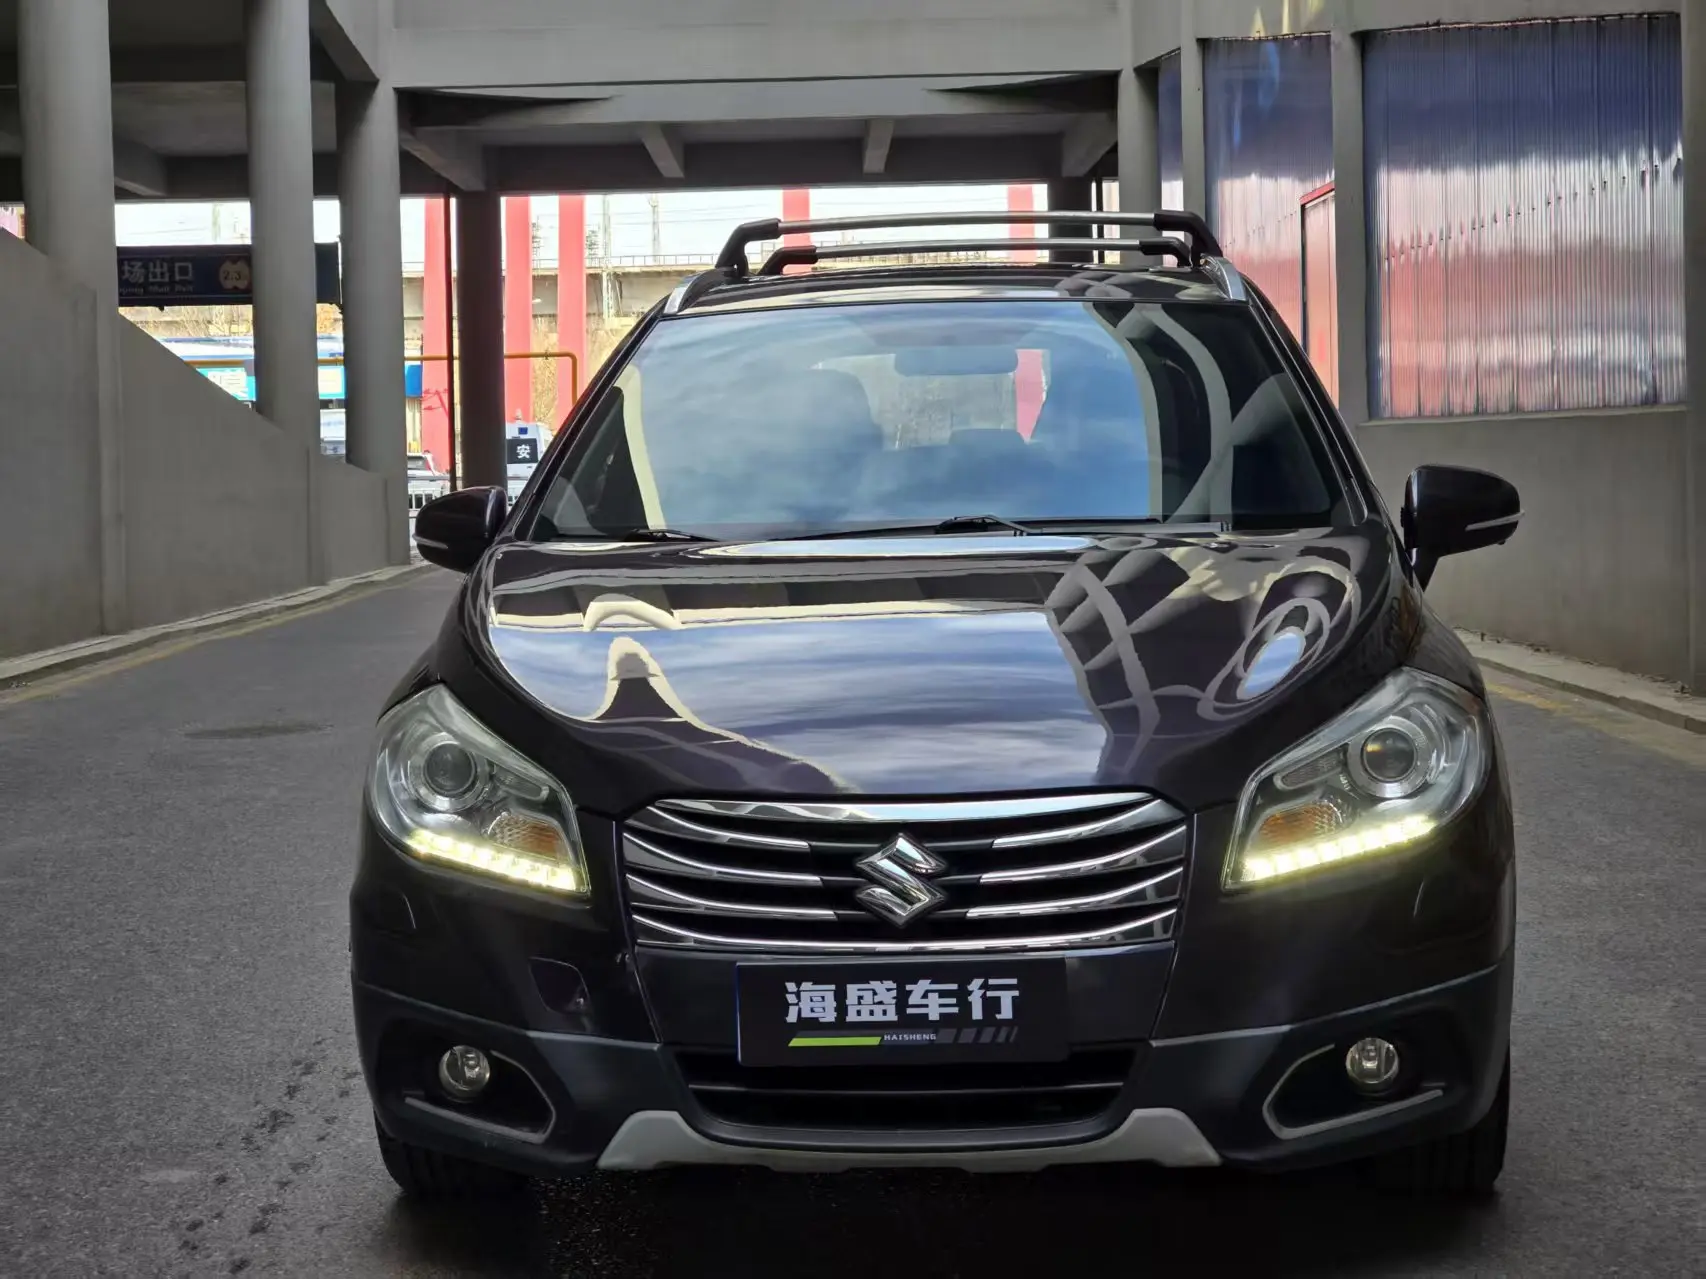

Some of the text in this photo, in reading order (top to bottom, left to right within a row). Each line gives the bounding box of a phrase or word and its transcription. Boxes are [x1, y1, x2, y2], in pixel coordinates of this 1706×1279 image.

[121, 260, 194, 283] 场出口
[516, 444, 531, 459] 安
[785, 978, 1019, 1023] 海盛车行
[883, 1033, 937, 1041] HAISHENG
